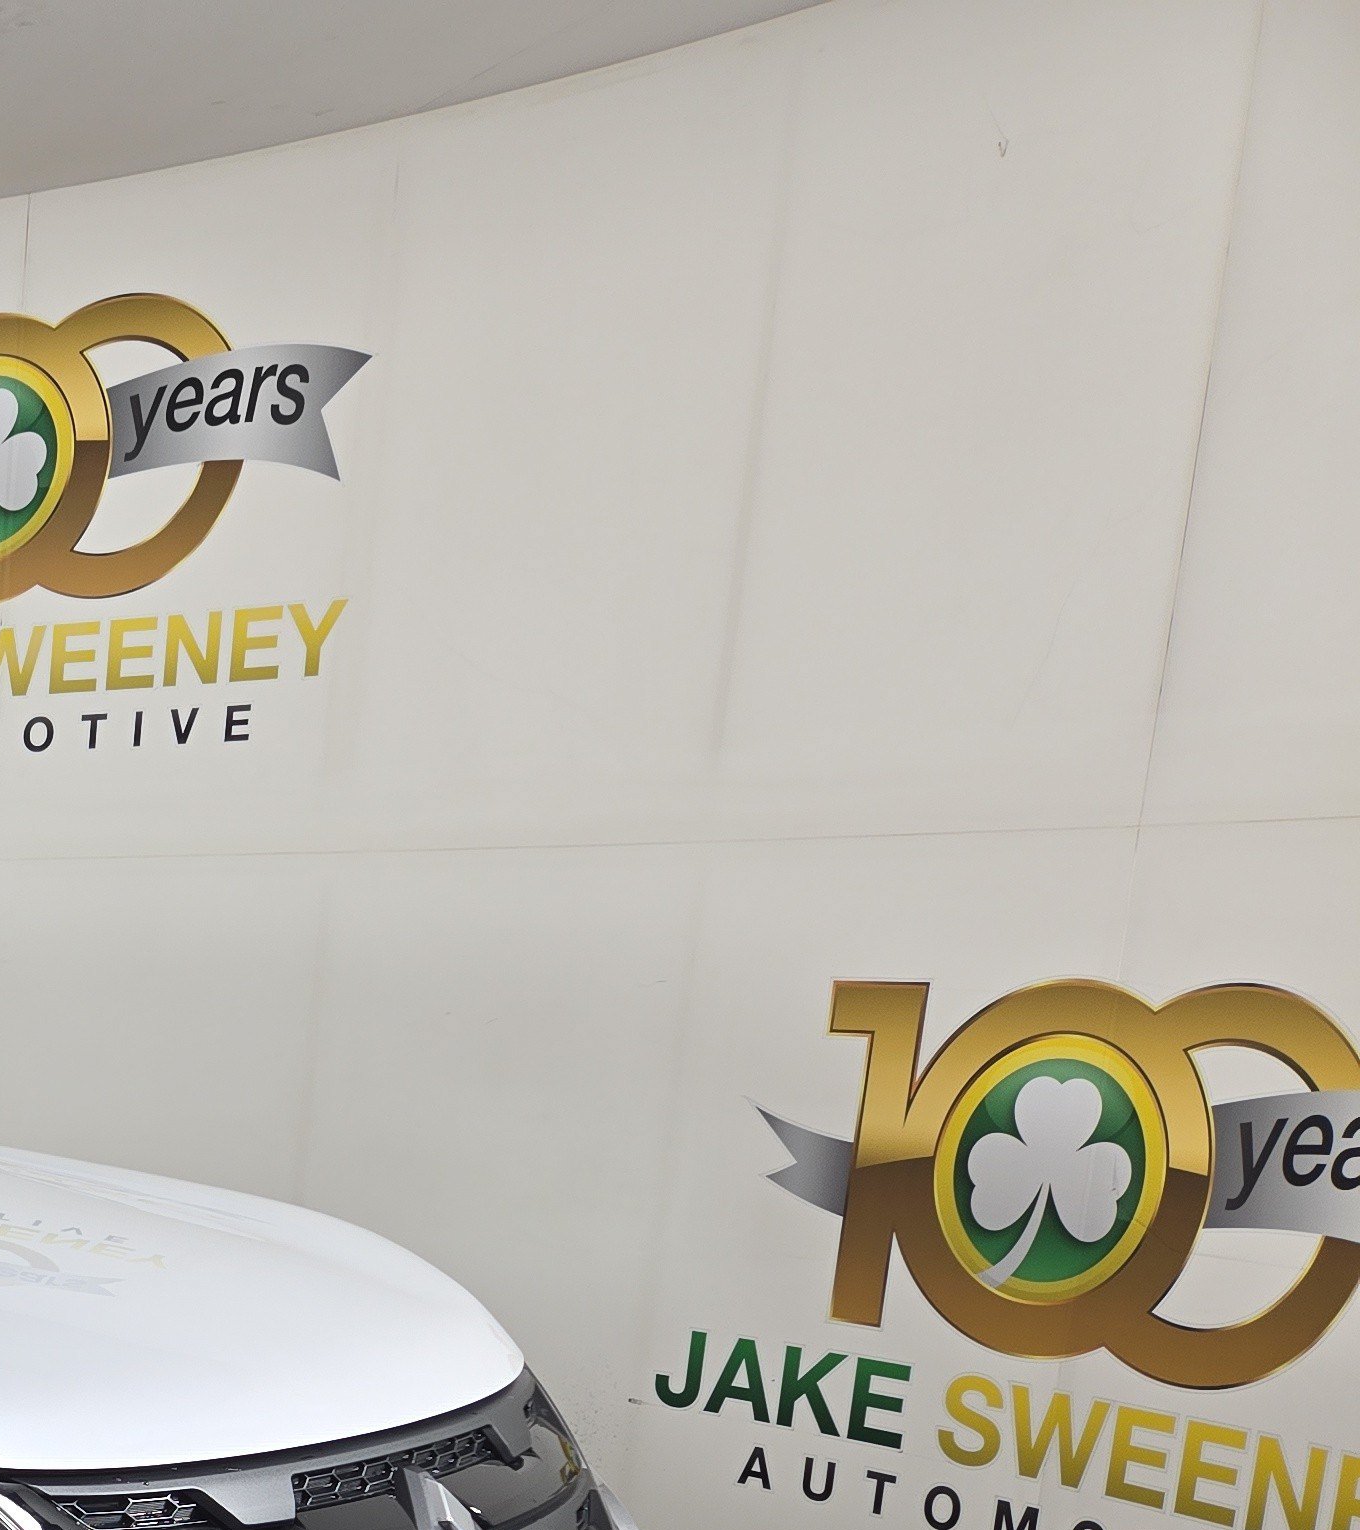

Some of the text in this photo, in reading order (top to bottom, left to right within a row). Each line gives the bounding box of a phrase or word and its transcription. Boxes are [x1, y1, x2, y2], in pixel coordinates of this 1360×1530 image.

[124, 363, 309, 462] years
[1225, 1114, 1360, 1211] yea
[655, 1331, 912, 1450] JAKE
